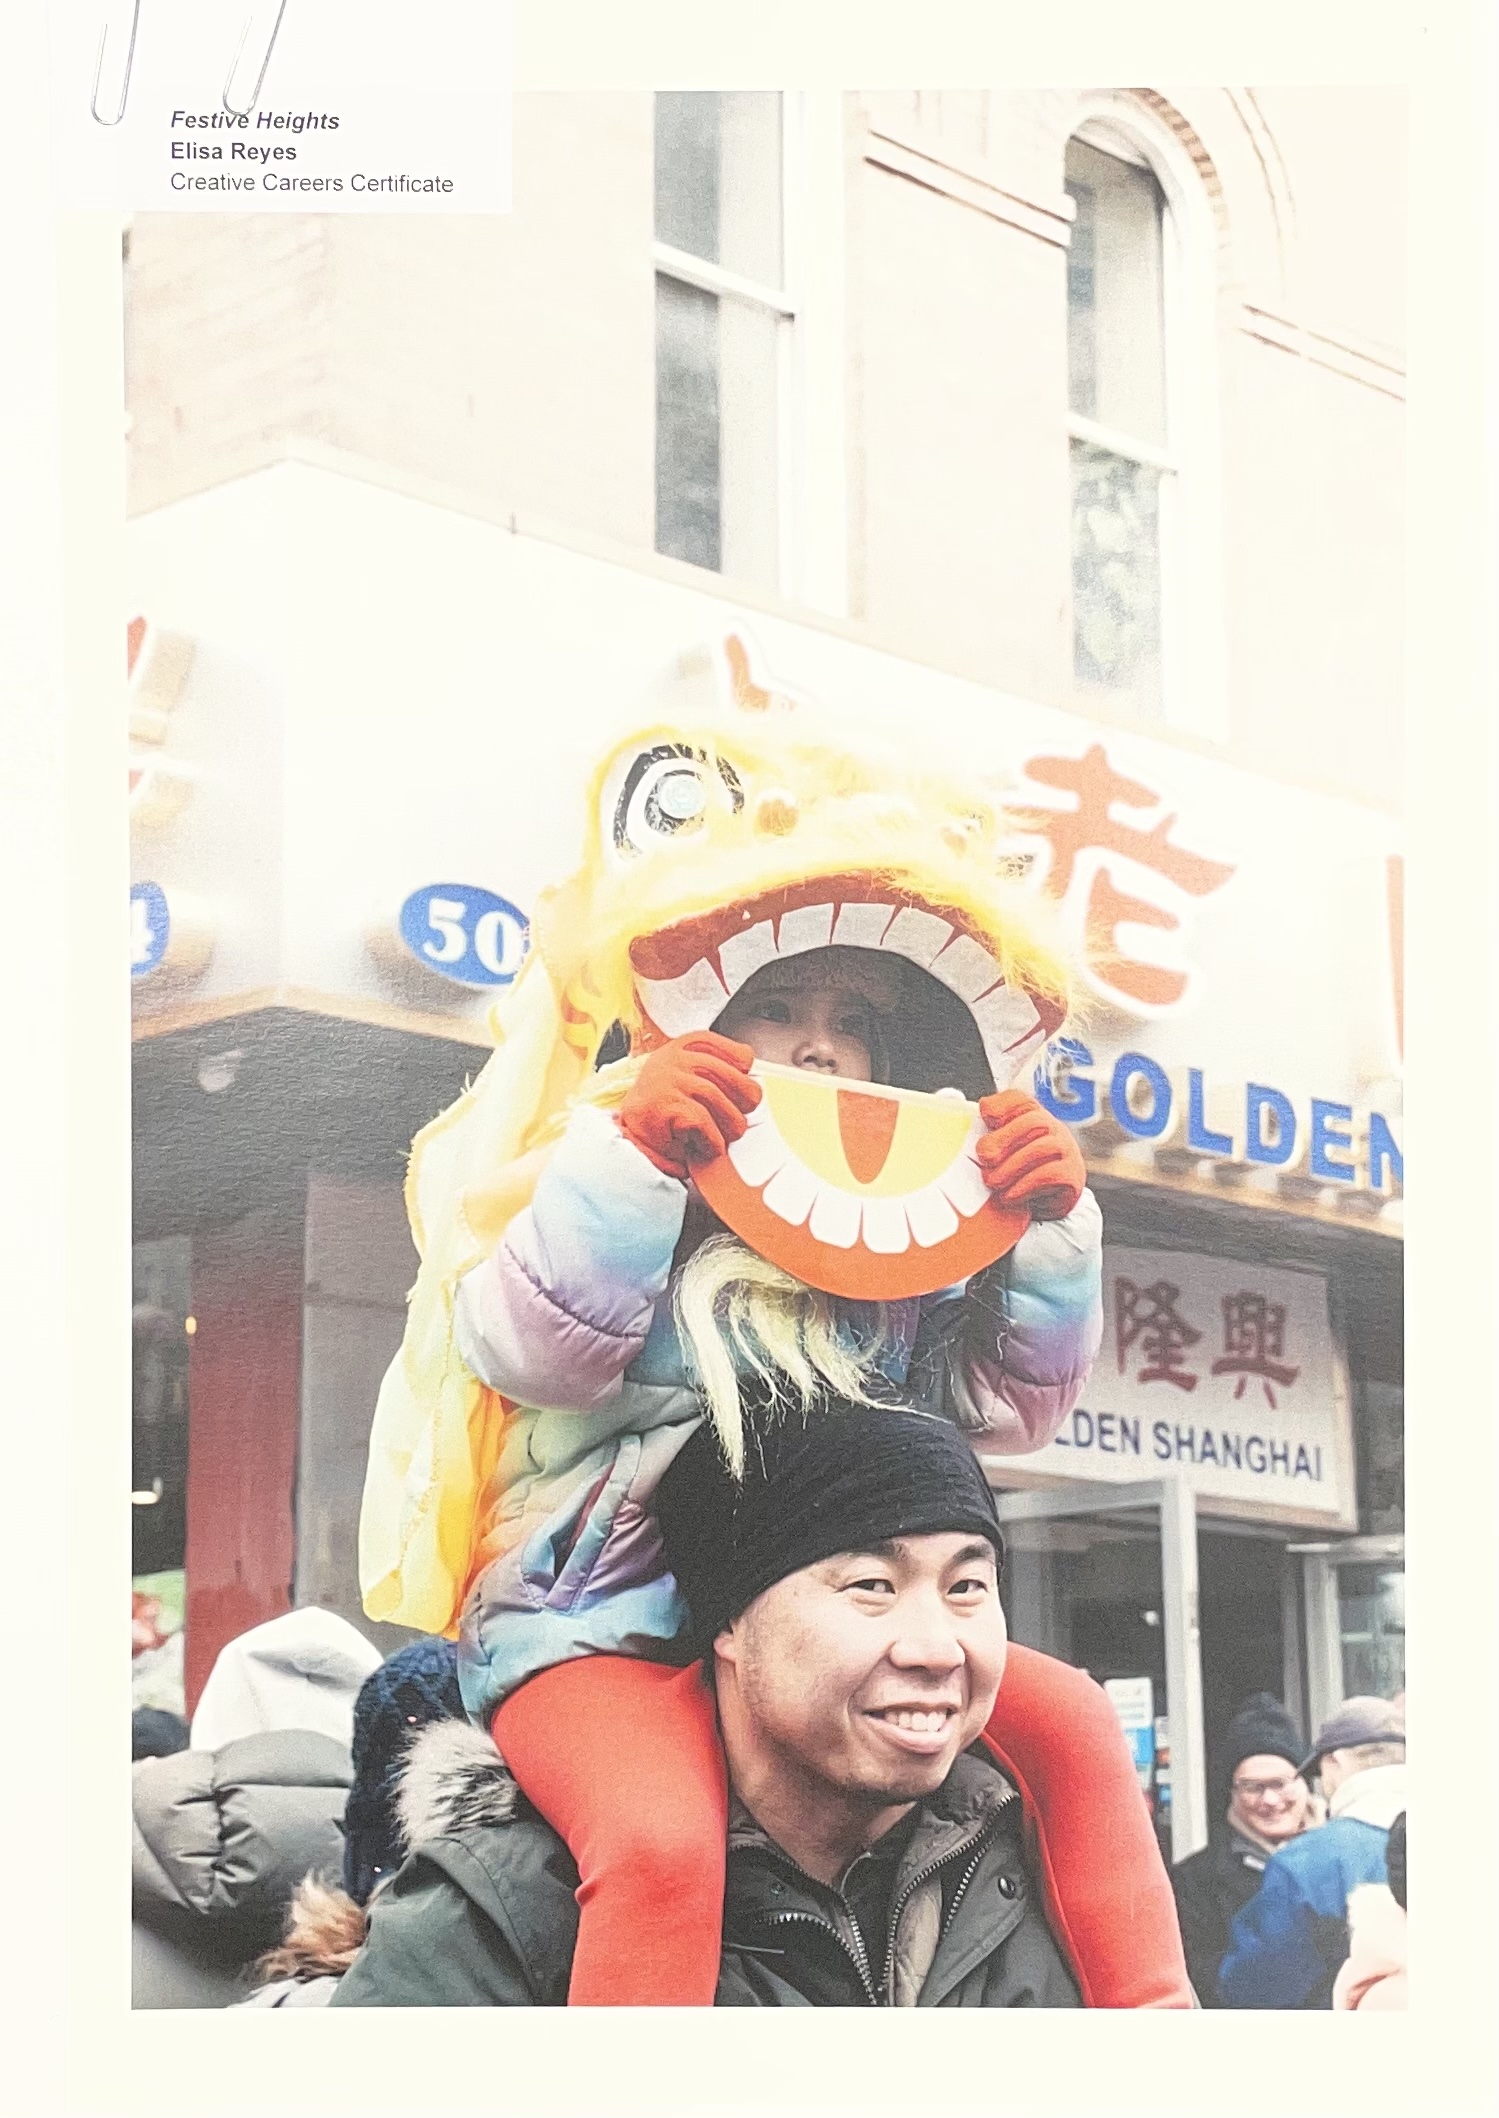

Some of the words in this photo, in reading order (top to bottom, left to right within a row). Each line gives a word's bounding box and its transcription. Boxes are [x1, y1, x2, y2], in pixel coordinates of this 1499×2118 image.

[170, 110, 250, 129] Festive
[256, 111, 340, 134] Heights
[171, 142, 223, 160] Elisa
[231, 142, 297, 164] Reyes
[170, 172, 255, 191] Creative
[262, 173, 344, 192] Careers
[351, 173, 455, 193] Certificate
[1034, 1036, 1403, 1190] GOLDEN
[1152, 1421, 1322, 1481] SHANGHAI
